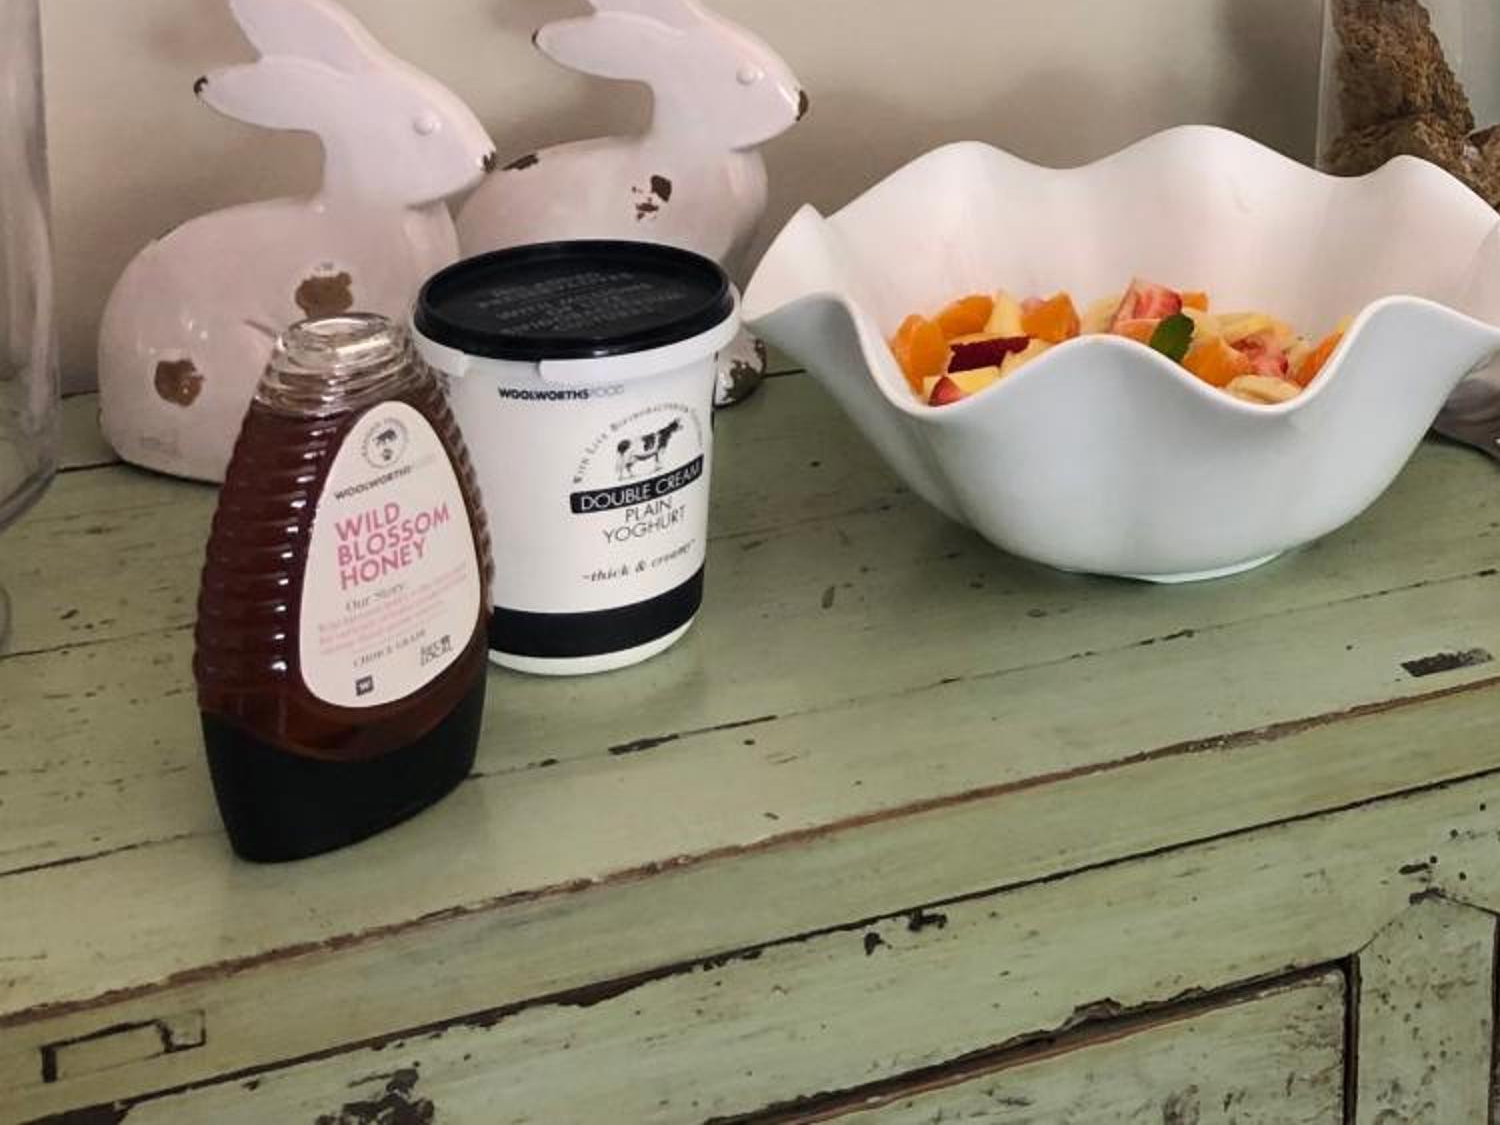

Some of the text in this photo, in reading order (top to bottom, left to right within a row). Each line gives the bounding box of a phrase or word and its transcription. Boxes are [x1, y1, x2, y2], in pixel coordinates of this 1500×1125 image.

[580, 460, 701, 511] DOUBLE CREAM
[334, 501, 400, 542] WILD
[603, 504, 687, 544] YOGHURT
[625, 495, 673, 523] PLAIN
[337, 502, 450, 567] BLOSSOM
[340, 538, 426, 591] HONEY
